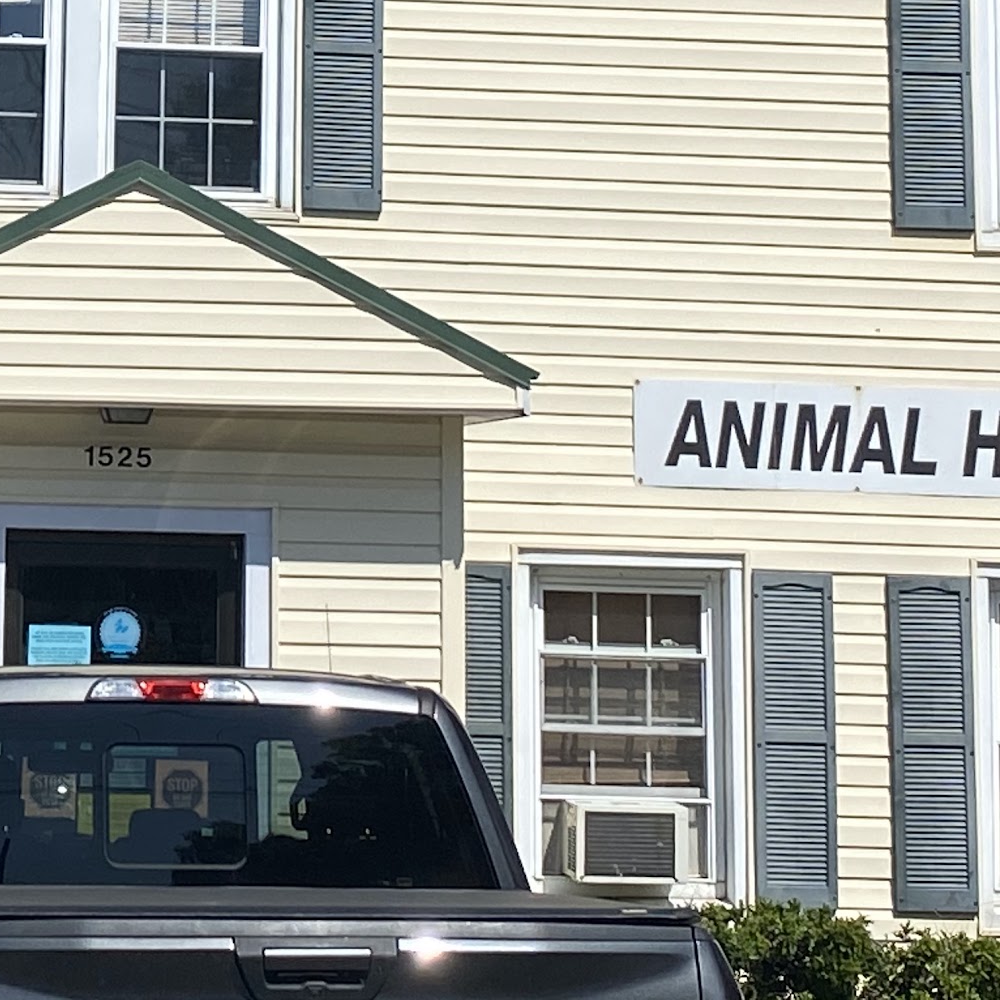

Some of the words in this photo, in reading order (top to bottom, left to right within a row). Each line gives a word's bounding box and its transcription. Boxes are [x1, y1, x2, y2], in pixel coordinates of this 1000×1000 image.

[664, 398, 938, 476] ANIMAL
[84, 445, 153, 468] 1525
[166, 776, 198, 792] STOP
